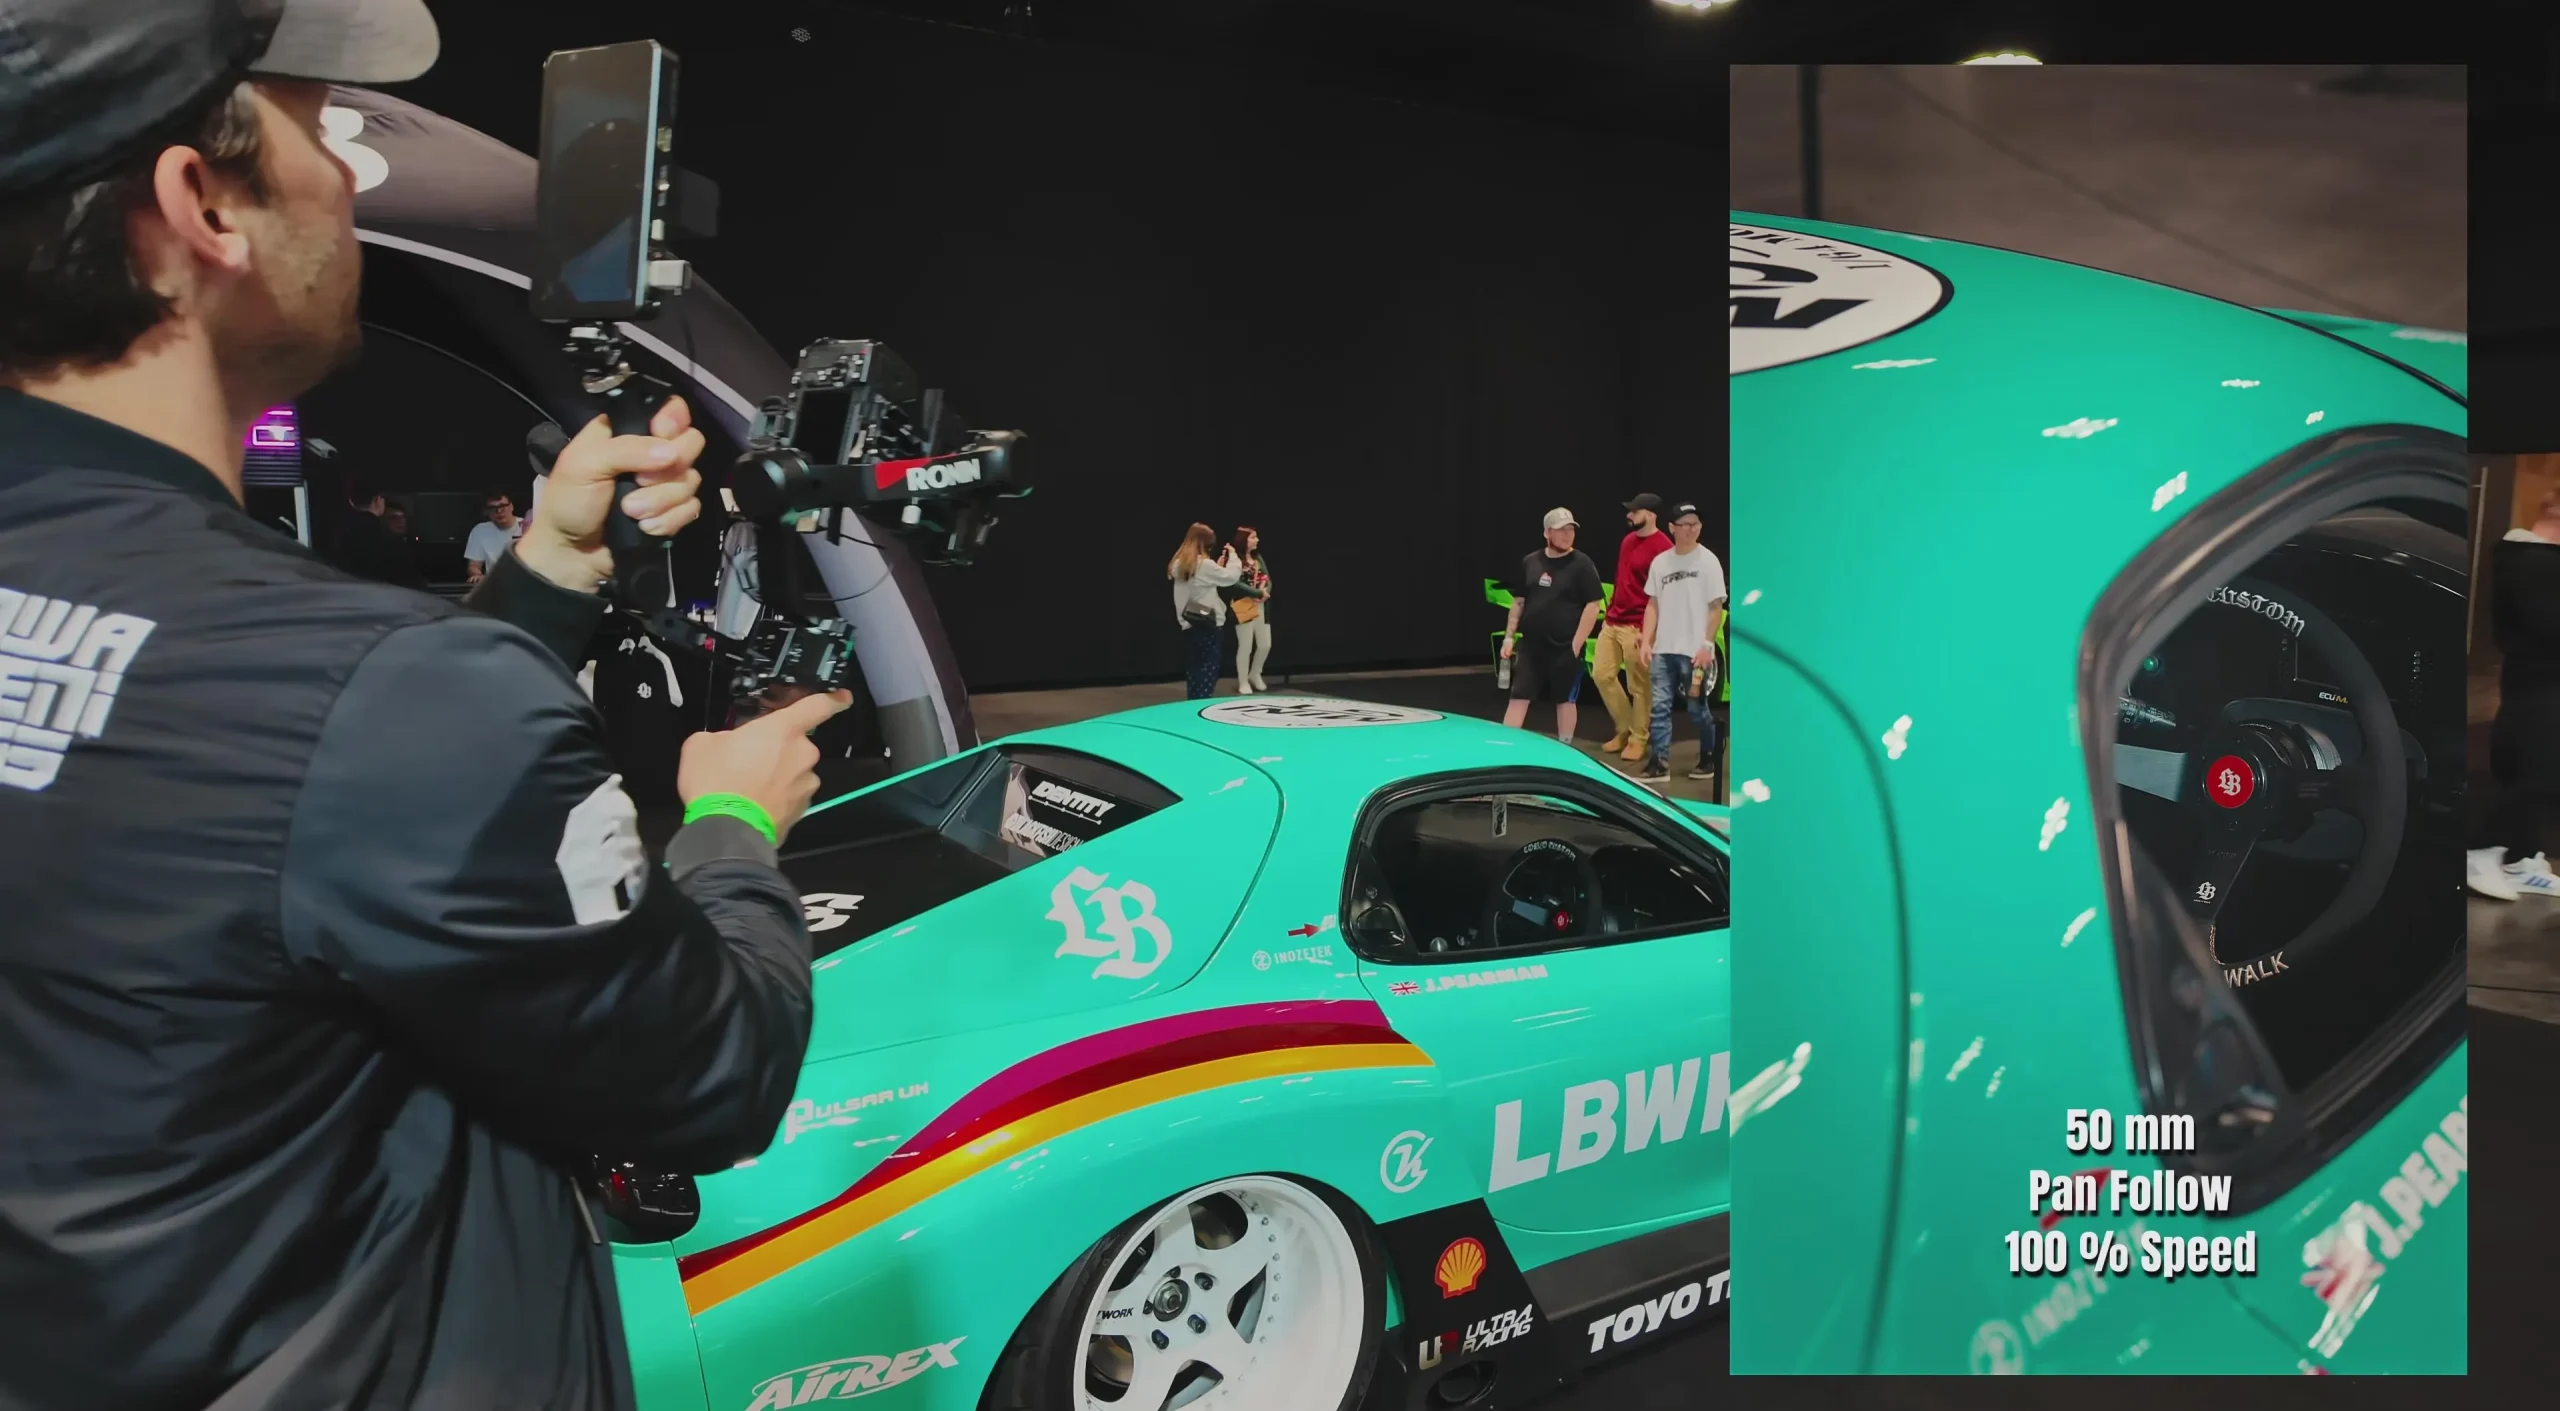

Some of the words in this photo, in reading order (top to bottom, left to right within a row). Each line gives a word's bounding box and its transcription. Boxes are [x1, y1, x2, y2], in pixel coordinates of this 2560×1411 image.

[1425, 963, 1548, 993] J.PEARMAN
[2224, 951, 2290, 988] WALK
[784, 1091, 894, 1144] PULSAR
[898, 1081, 929, 1100] UK
[1101, 1307, 1134, 1320] WORK
[1465, 1303, 1533, 1340] ULTRA
[1587, 1282, 1702, 1354] TOYO
[1461, 1316, 1534, 1356] RACING
